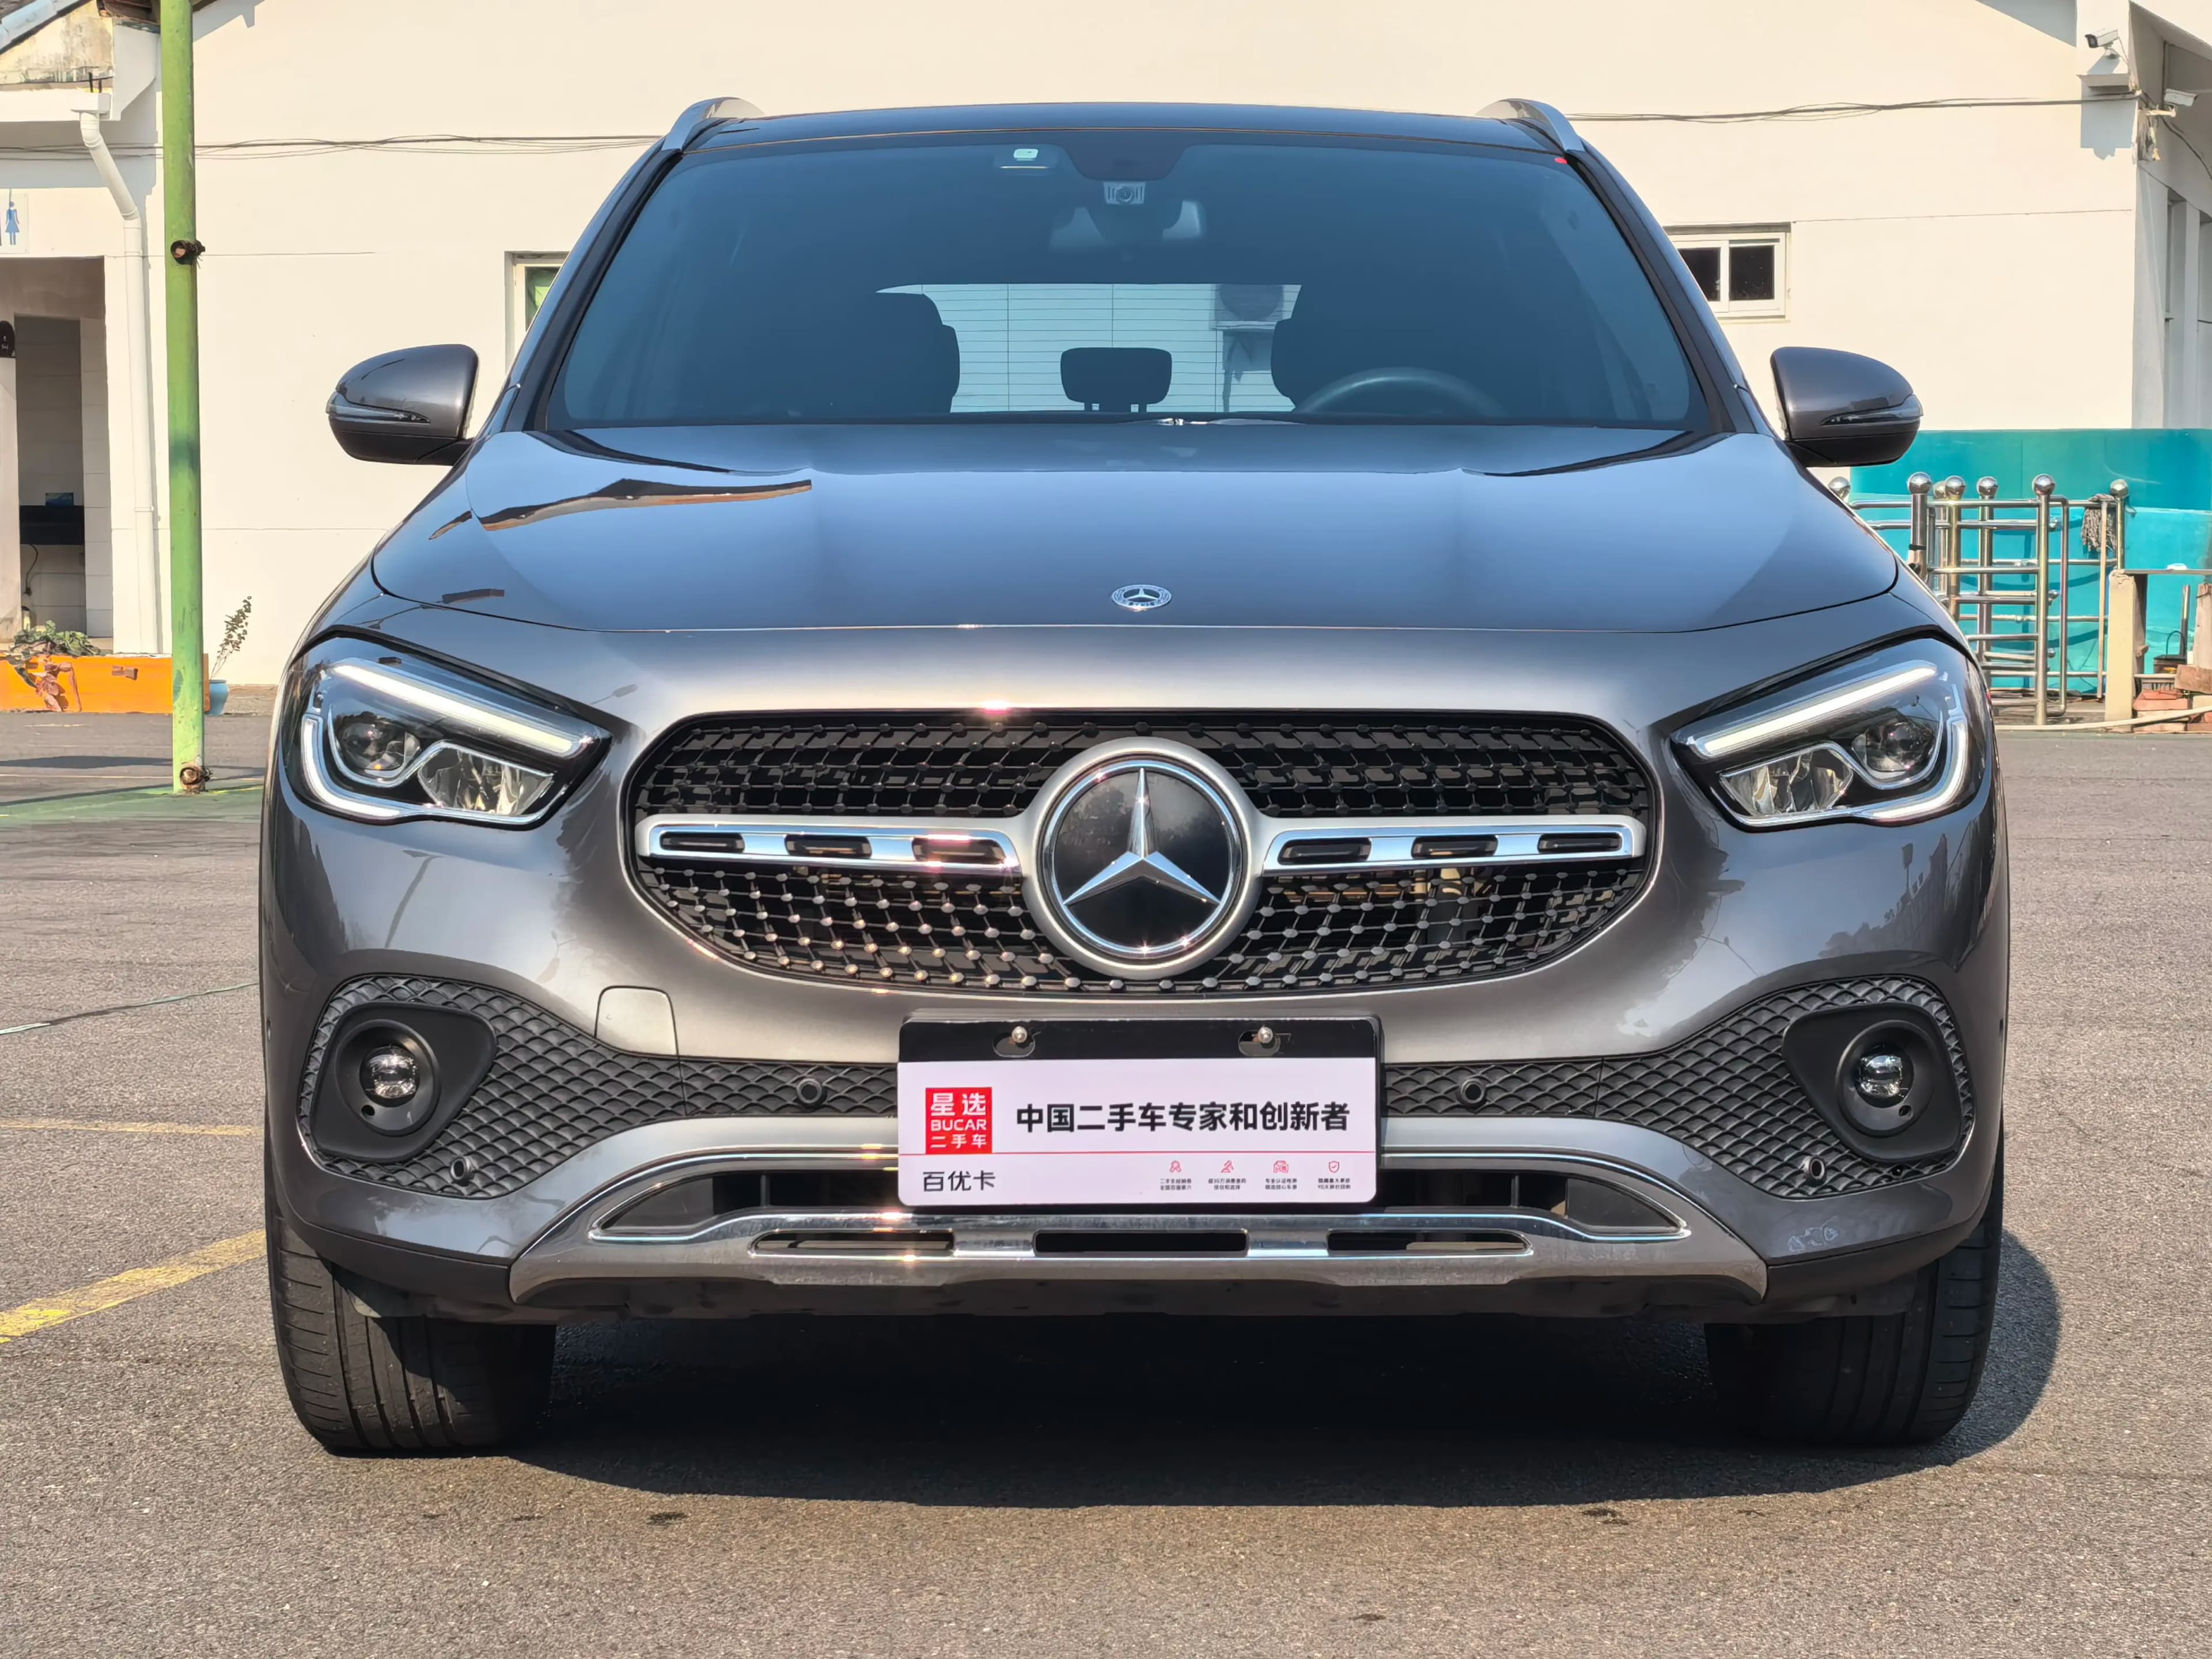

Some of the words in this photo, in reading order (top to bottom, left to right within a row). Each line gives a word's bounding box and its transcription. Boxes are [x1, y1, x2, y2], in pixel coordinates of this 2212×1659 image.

[930, 1092, 986, 1116] 星选
[930, 1119, 987, 1131] BUCAR
[1017, 1101, 1350, 1133] 中国二手车专家和创新者
[930, 1134, 987, 1149] 二手车
[923, 1170, 996, 1192] 百优卡
